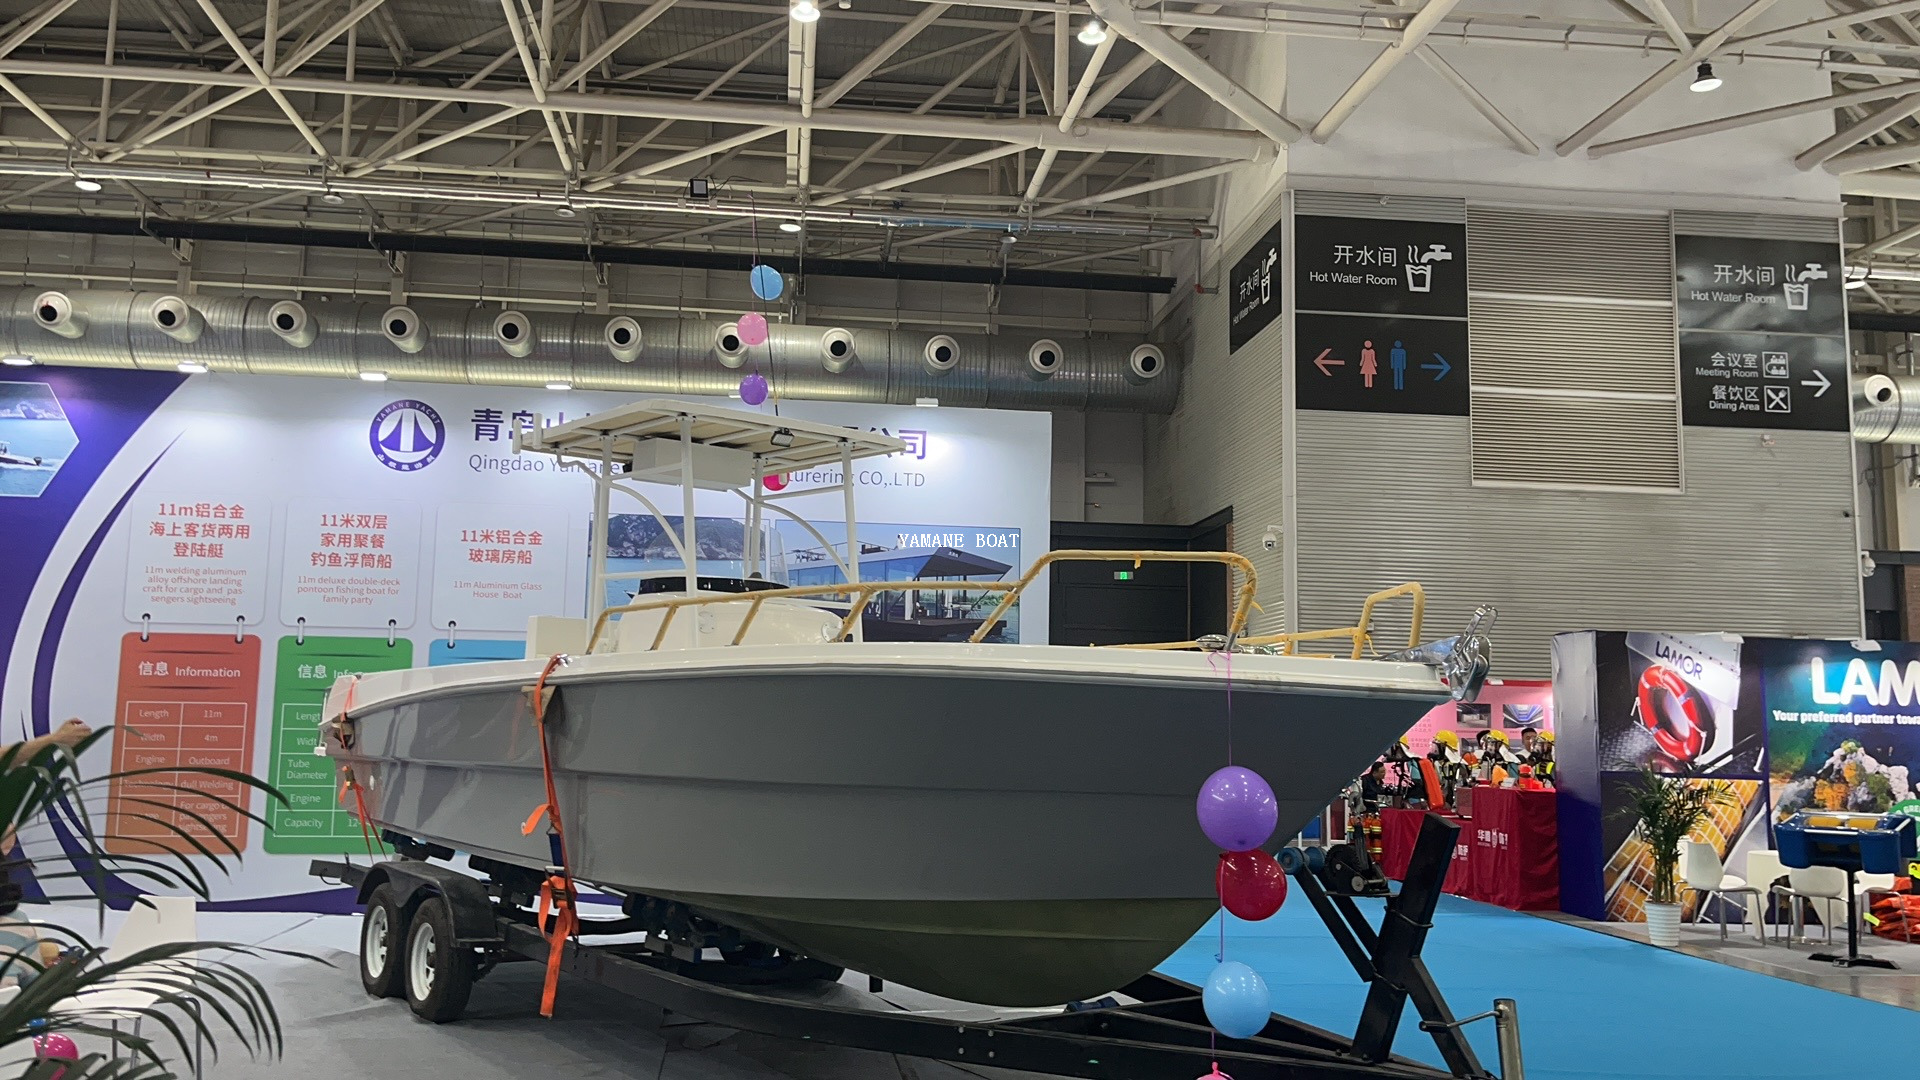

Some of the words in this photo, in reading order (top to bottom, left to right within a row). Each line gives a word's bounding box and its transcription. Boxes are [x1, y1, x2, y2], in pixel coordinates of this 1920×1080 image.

[1333, 244, 1398, 268] 开水间
[1309, 271, 1329, 282] Hot
[1331, 272, 1362, 284] Water
[1365, 273, 1397, 286] Room
[1714, 263, 1775, 286] 开水间
[1240, 268, 1260, 303] 开水间
[1691, 290, 1709, 301] Hot
[1711, 291, 1743, 303] Water
[1745, 292, 1776, 304] Room
[1710, 351, 1758, 368] 会议室
[1695, 367, 1731, 379] Meeting
[1732, 368, 1759, 378] Room
[1712, 384, 1760, 402] 餐饮区
[1709, 401, 1737, 412] Dining
[1739, 402, 1760, 411] Area
[376, 402, 410, 422] YAMANE
[415, 403, 440, 424] YACHT
[469, 454, 544, 475] Qingdao
[158, 503, 245, 519] 11m铝合金
[320, 513, 388, 530] 11米双层
[149, 521, 250, 539] 海上客货两用
[320, 532, 386, 549] 家用聚餐
[460, 529, 543, 546] 11米铝合金
[173, 541, 224, 558] 登陆艇
[310, 551, 393, 569] 钓鱼浮筒船
[468, 548, 533, 565] 玻璃房船
[145, 565, 163, 574] 11m
[166, 566, 200, 577] welding
[202, 567, 247, 576] aluminum
[147, 575, 169, 586] alloy
[171, 576, 207, 585] offshore
[209, 577, 242, 588] landing
[297, 576, 316, 584] 11m
[318, 576, 346, 585] deluxe
[348, 577, 401, 586] double-deck
[453, 580, 472, 589] 11m
[473, 581, 519, 590] Aluminium
[520, 582, 543, 591] Glass
[142, 584, 163, 593] craft
[165, 585, 177, 593] for
[179, 587, 204, 596] cargo
[206, 586, 223, 595] and
[297, 586, 334, 594] pontoon
[336, 586, 365, 596] fishing
[366, 587, 386, 595] boat
[387, 588, 400, 596] for
[472, 591, 499, 599] House
[502, 591, 523, 600] Boat
[151, 595, 185, 605] sengers
[187, 595, 236, 606] sightseeing
[322, 595, 350, 605] family
[351, 596, 374, 605] party
[1655, 640, 1703, 680] LAMOR
[138, 661, 169, 676] 信息
[175, 666, 241, 678] Information
[297, 663, 327, 679] 信息
[139, 709, 169, 720] Length
[203, 709, 222, 719] 11m
[295, 711, 321, 723] Lengt
[1773, 710, 1799, 721] Your
[1800, 711, 1853, 724] preferred
[1853, 713, 1895, 726] partner
[204, 734, 219, 742] 4m
[296, 736, 318, 746] Widt
[135, 754, 166, 766] Engine
[188, 756, 230, 766] Outboard
[287, 759, 310, 768] Tube
[286, 770, 328, 780] Diameter
[199, 780, 234, 791] Welding
[290, 793, 321, 805] Engine
[196, 802, 220, 811] cargo
[284, 818, 323, 829] Capacity
